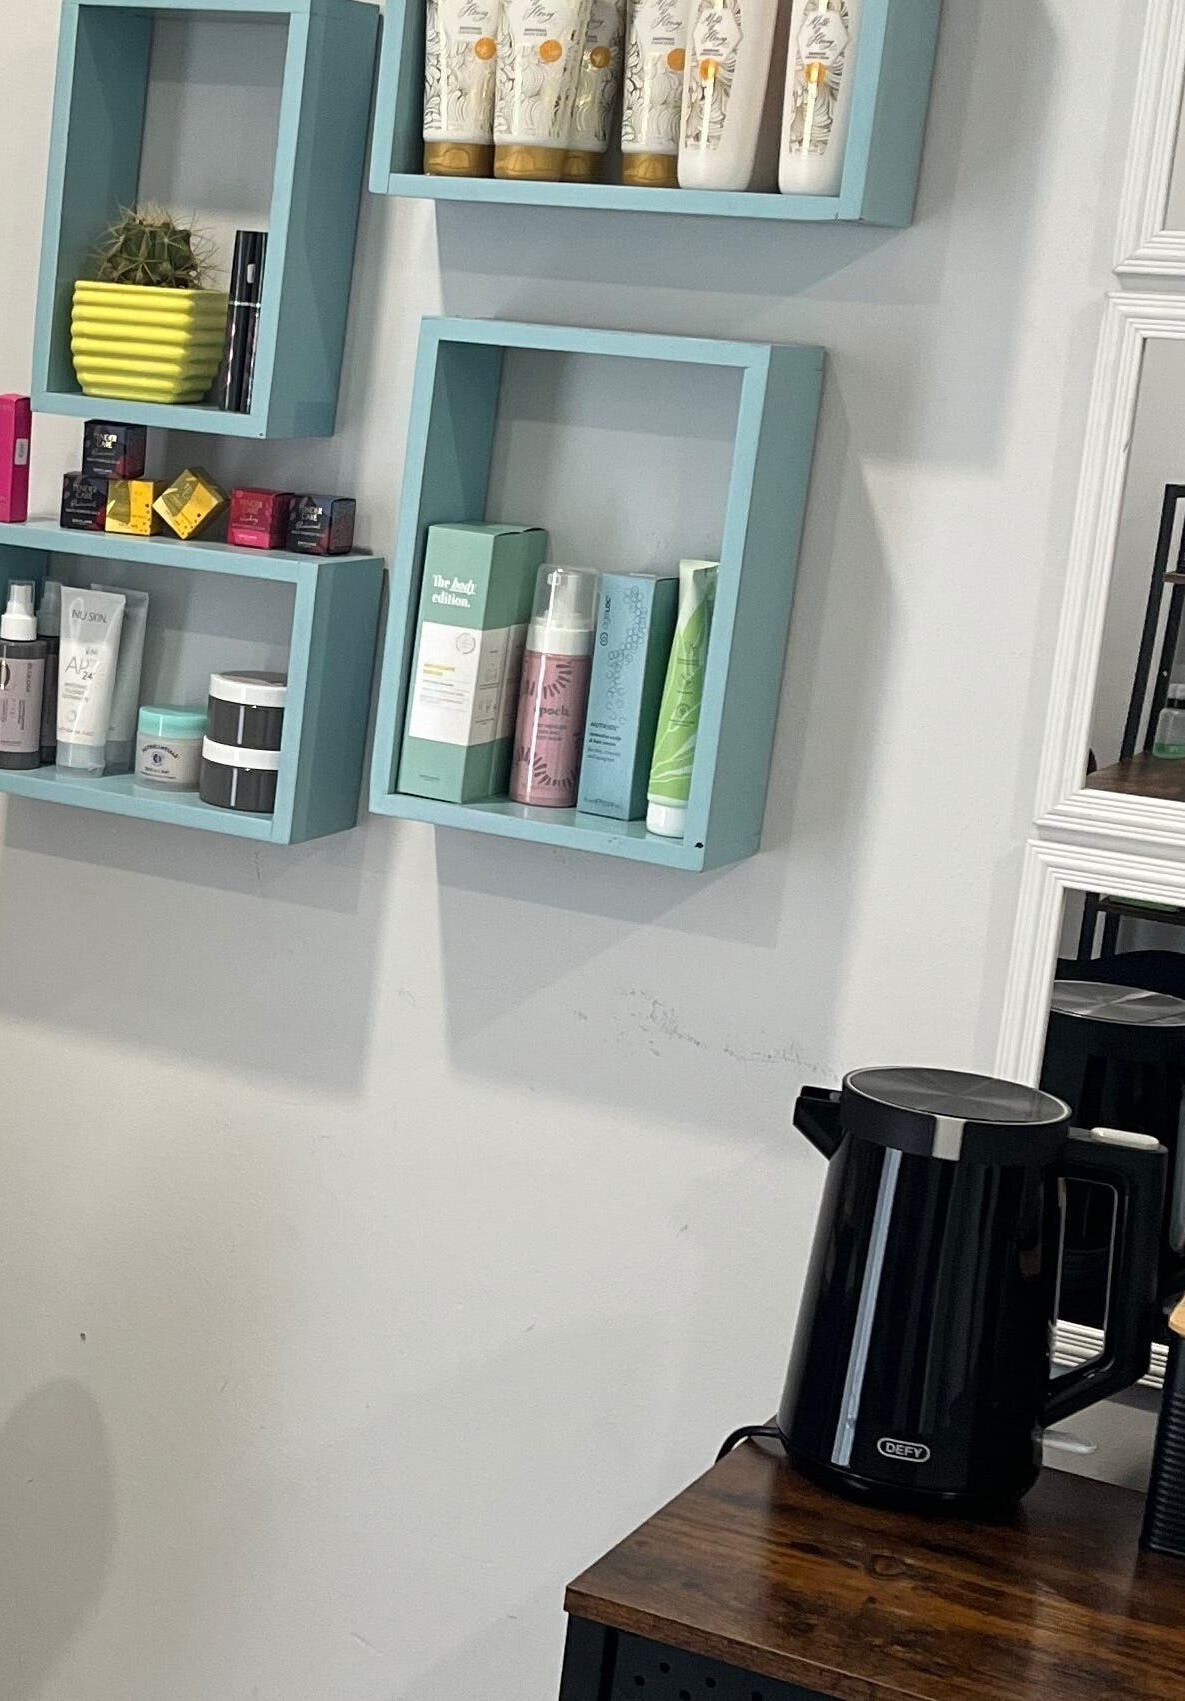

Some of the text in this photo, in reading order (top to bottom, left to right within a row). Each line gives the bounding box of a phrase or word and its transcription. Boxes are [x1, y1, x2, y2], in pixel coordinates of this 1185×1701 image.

[432, 574, 476, 596] The body
[431, 590, 472, 609] edition.
[71, 609, 88, 621] NU
[885, 1442, 923, 1458] DEFY
